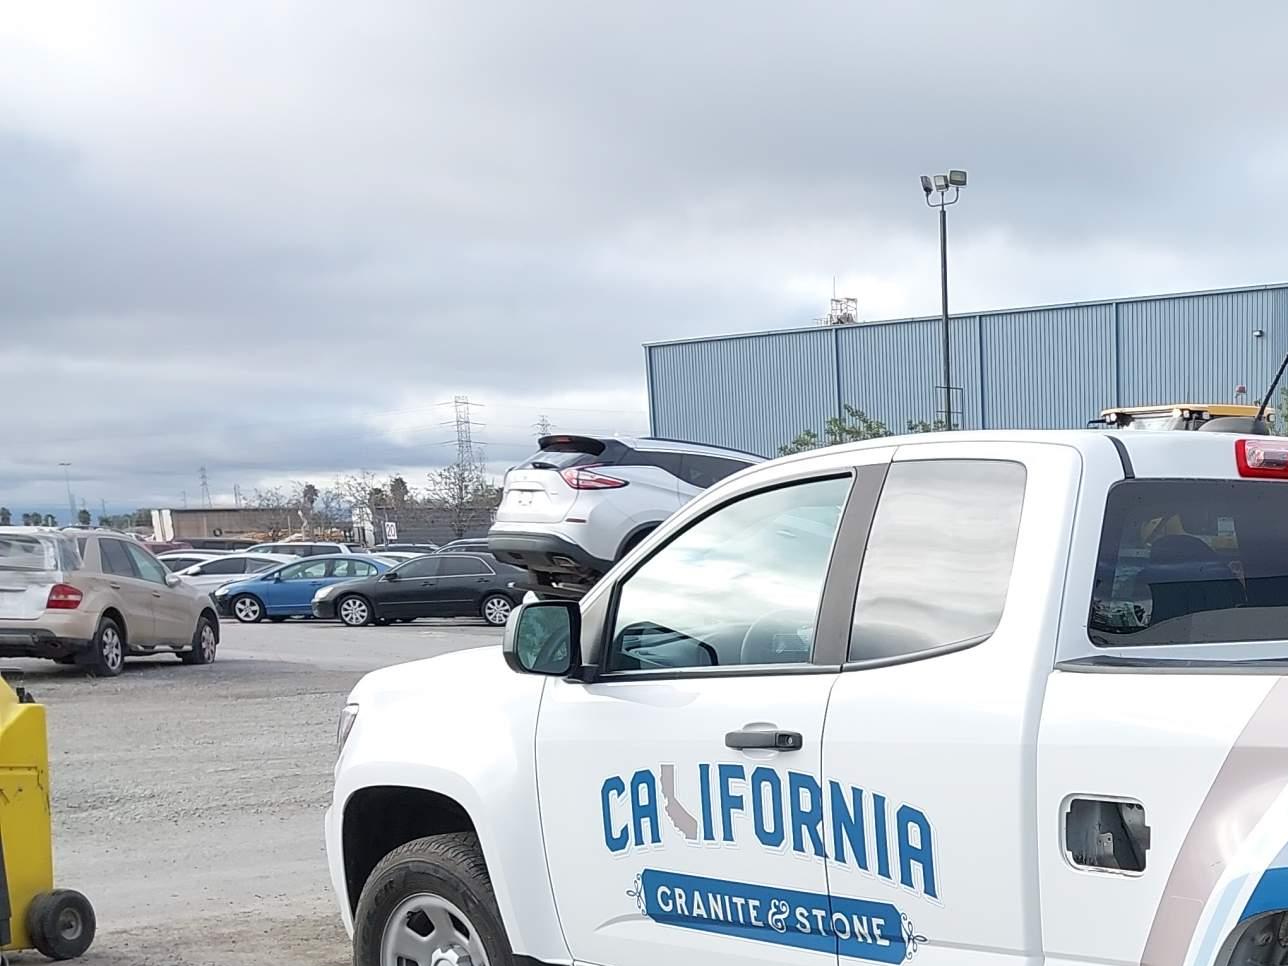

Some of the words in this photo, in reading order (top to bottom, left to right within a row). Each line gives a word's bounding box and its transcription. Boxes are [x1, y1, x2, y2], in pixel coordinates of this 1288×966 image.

[386, 524, 396, 537] 20
[601, 763, 939, 899] CALIFORNIA
[656, 886, 764, 927] GRANITE
[768, 899, 790, 933] &
[795, 906, 891, 946] STONE
